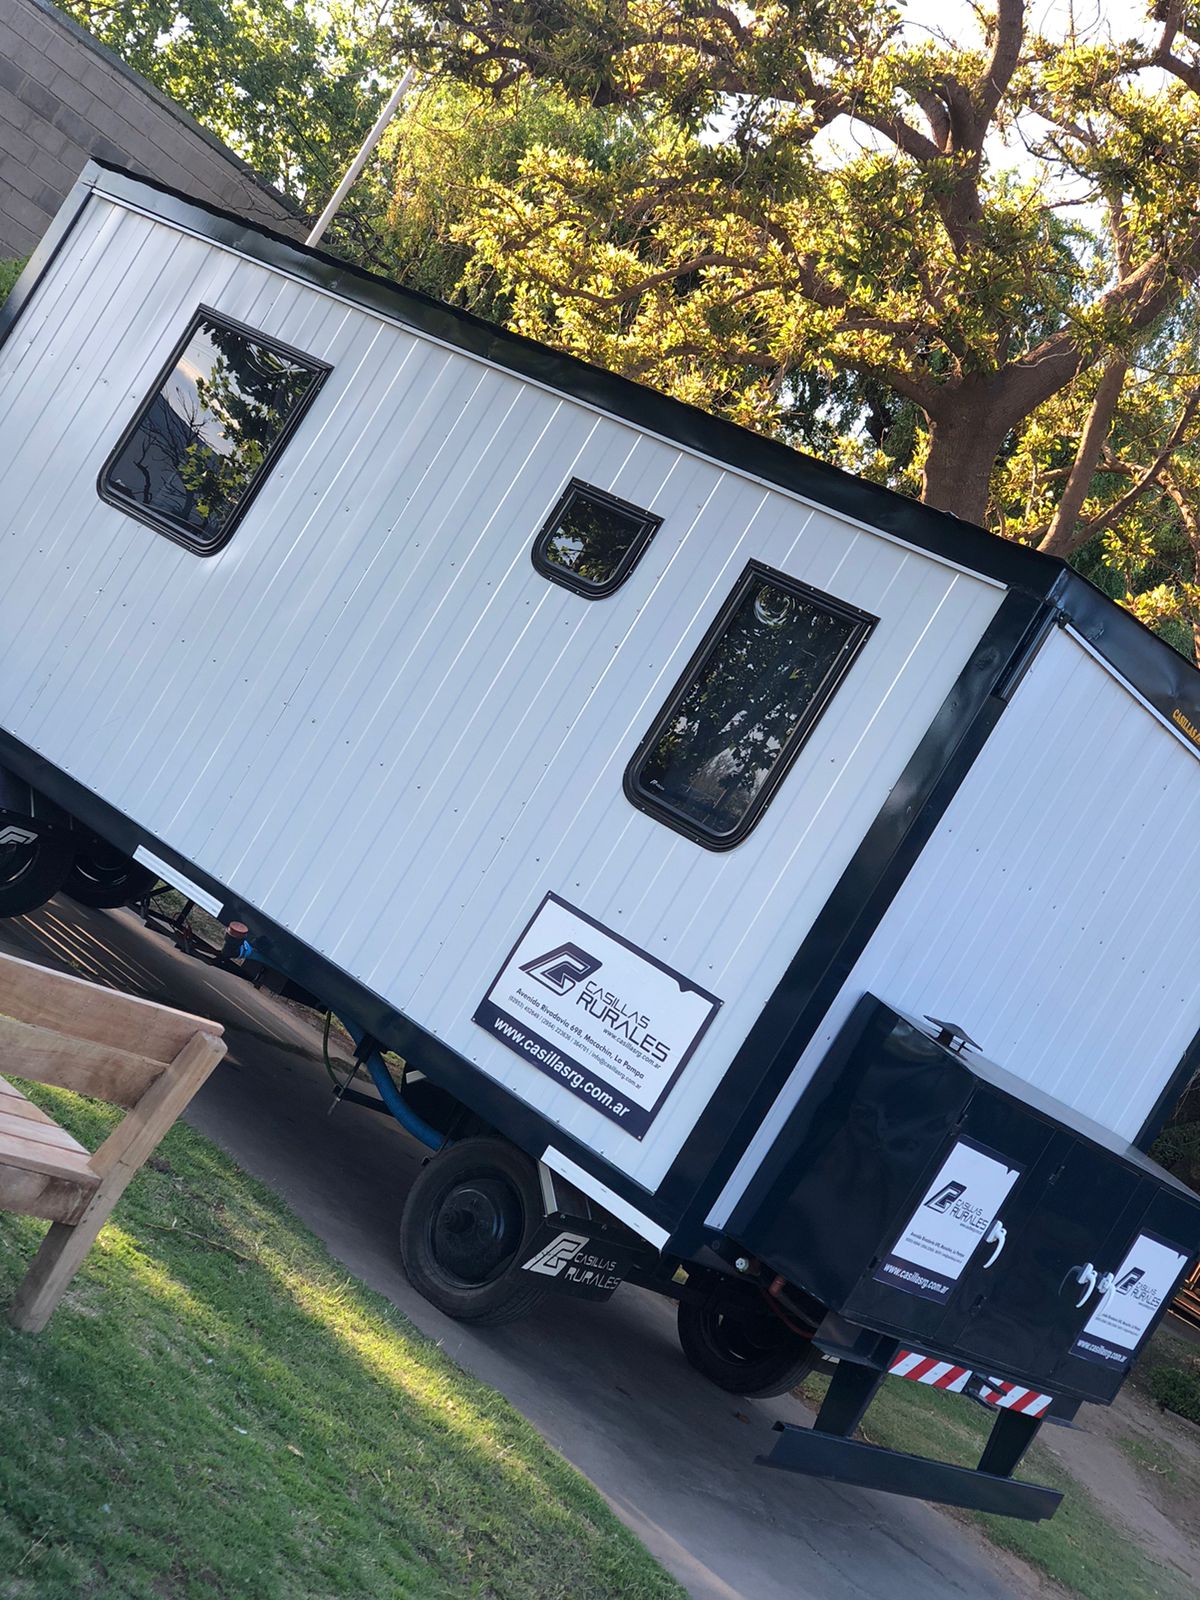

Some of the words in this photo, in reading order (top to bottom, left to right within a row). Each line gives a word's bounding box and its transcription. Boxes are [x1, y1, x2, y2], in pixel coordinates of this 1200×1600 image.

[585, 980, 651, 1030] CASILLAS
[515, 988, 541, 1008] Avenida
[540, 1004, 570, 1028] Rivadavia
[569, 1024, 583, 1039] 698,
[614, 1054, 623, 1065] La
[622, 1060, 645, 1080] Pampa
[575, 990, 671, 1063] RURALES
[493, 1016, 631, 1118] www.casillasrg.com.ar
[602, 1028, 662, 1069] www.casillasrg.com.ar
[949, 1206, 989, 1231] RURALES
[564, 1266, 622, 1290] RURALES
[574, 1252, 617, 1272] CASILLAS
[883, 1263, 950, 1295] www.casillasrg.com.ar
